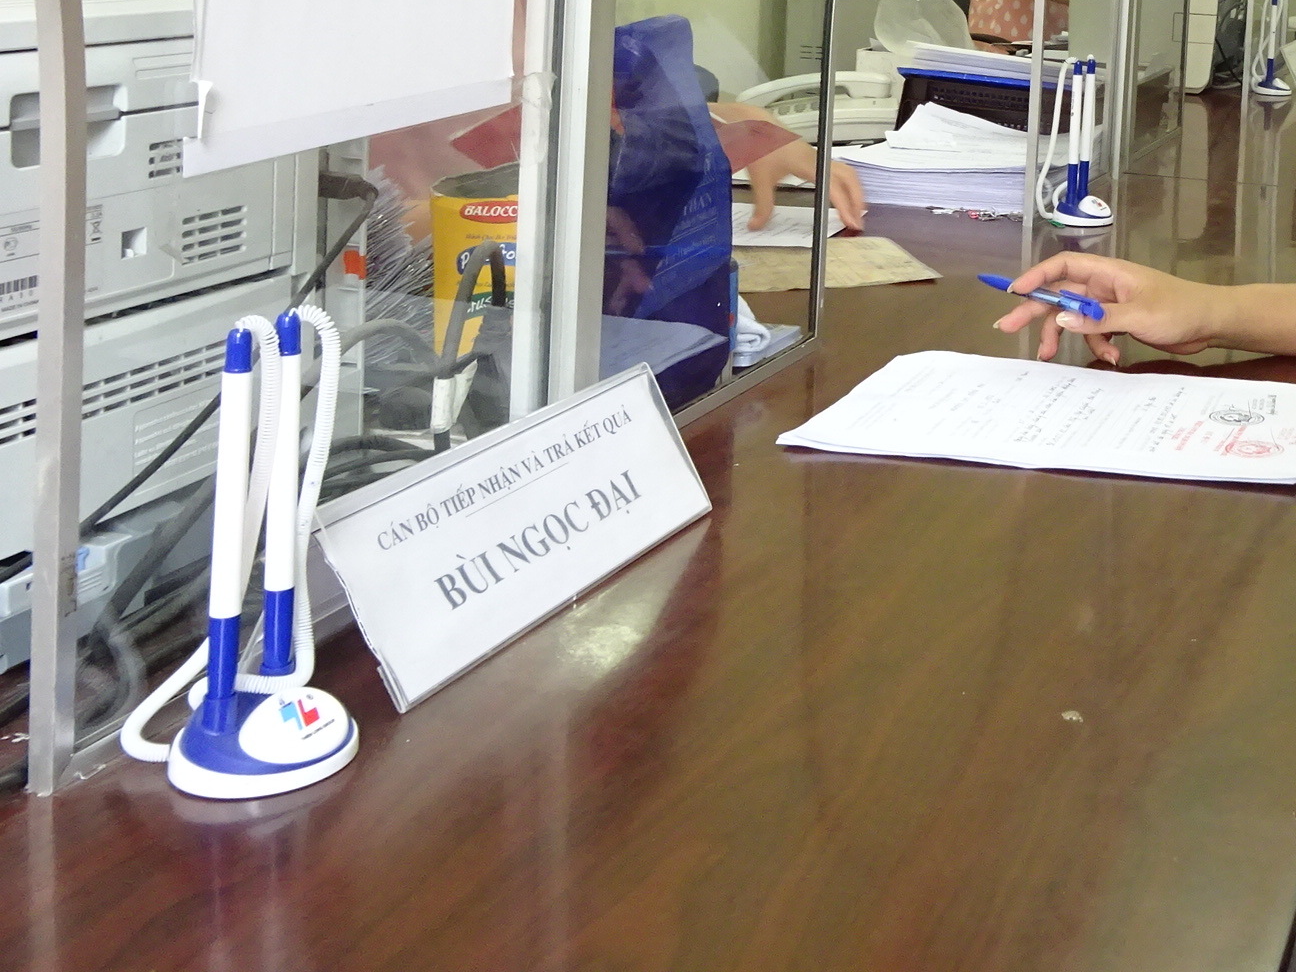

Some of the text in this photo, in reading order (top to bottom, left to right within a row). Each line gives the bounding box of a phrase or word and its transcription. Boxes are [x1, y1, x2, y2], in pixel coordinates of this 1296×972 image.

[464, 205, 518, 217] BALOCC
[376, 404, 633, 551] CÁN BỘ TIẾP NHẬN VÀ TRẢ KẾT QUẢ
[433, 469, 642, 611] BÙI NGỌC ĐẠI
